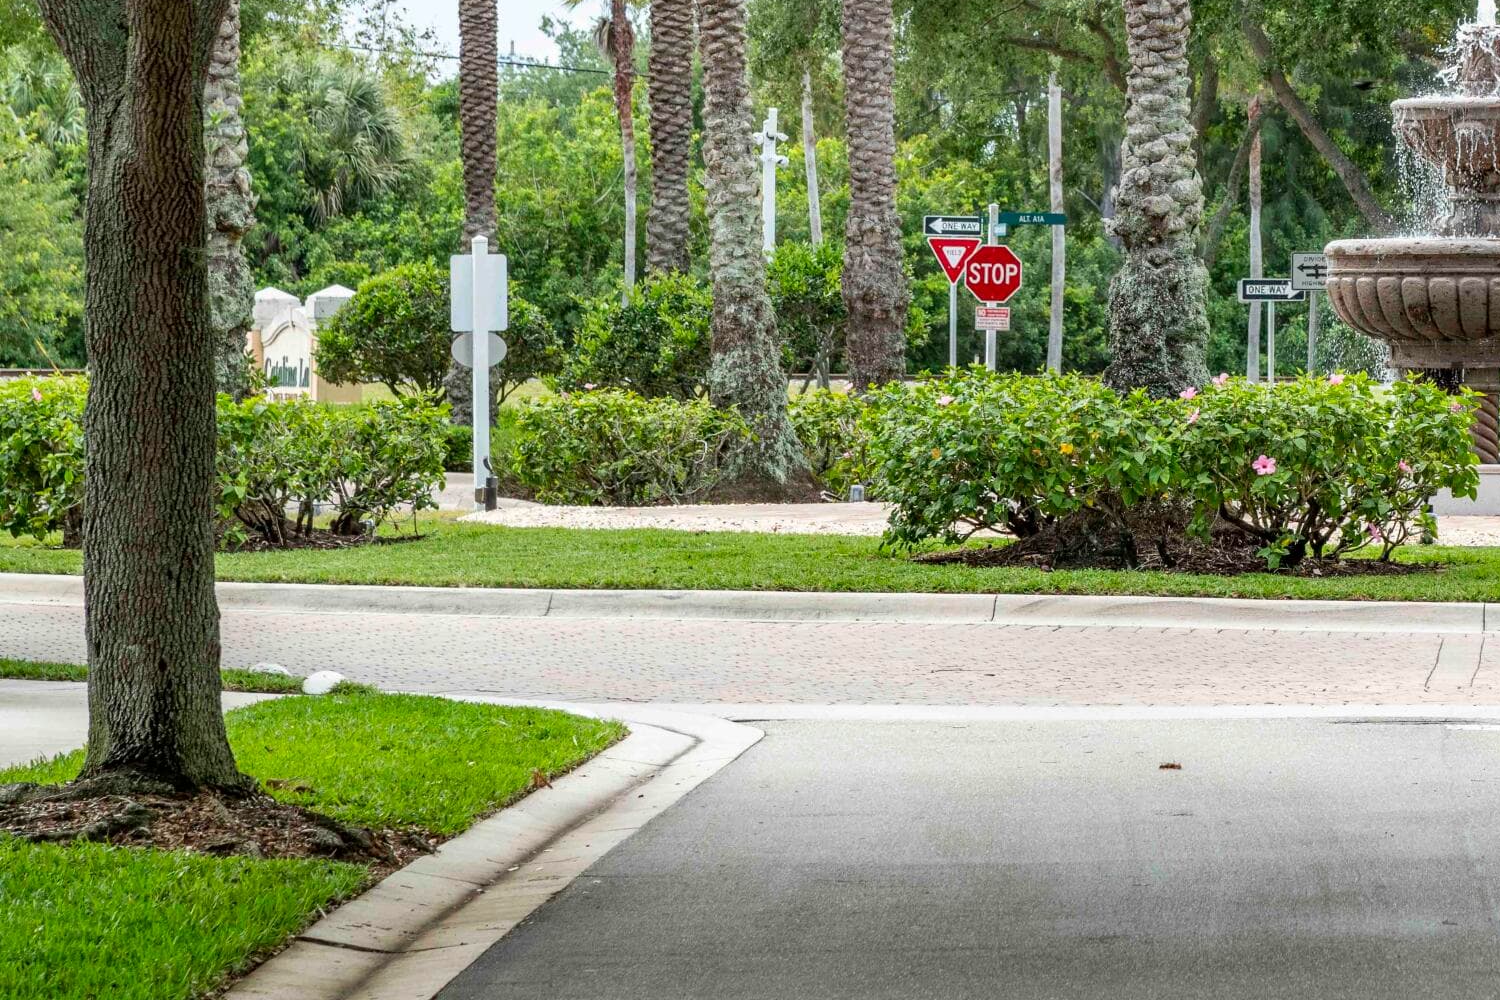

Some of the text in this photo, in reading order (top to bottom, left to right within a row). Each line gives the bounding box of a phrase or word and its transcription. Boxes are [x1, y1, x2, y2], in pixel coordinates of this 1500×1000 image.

[942, 222, 958, 230] ONE
[969, 262, 1018, 285] STOP
[1248, 285, 1287, 295] ONE WAY
